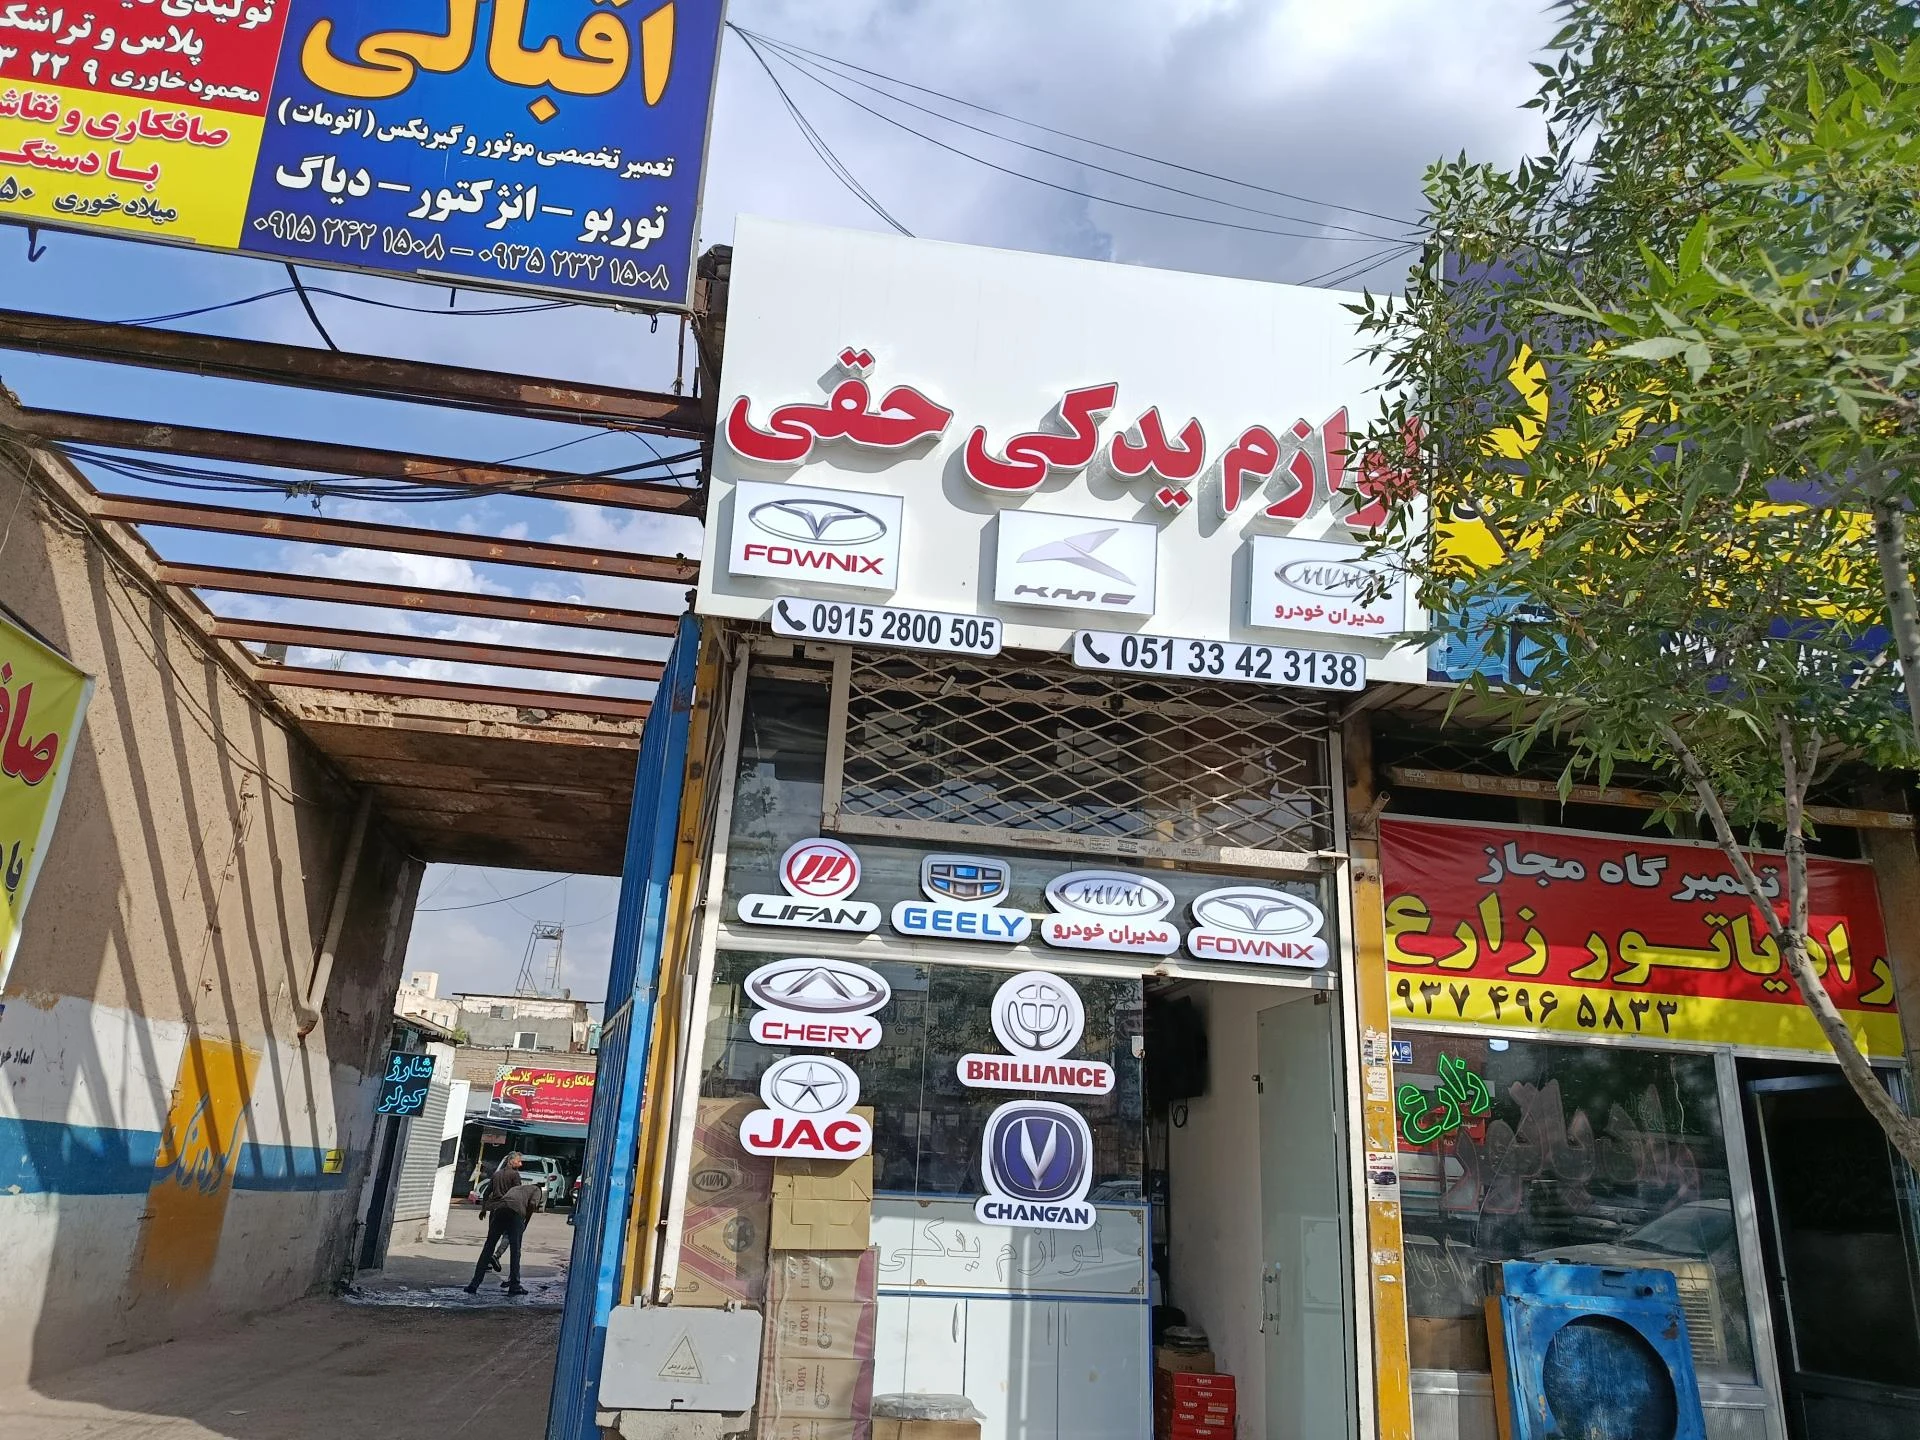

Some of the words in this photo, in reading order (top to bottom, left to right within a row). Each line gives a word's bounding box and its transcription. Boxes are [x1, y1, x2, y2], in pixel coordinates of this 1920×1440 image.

[93, 26, 117, 51] و
[120, 25, 204, 66] پلاس
[82, 58, 99, 86] ۹
[300, 0, 677, 124] اقبالی
[110, 68, 187, 93] خاوری
[188, 77, 261, 103] محمود
[57, 108, 82, 135] و
[84, 107, 230, 147] صافکاری
[376, 118, 464, 151] گیربکس
[463, 135, 478, 156] و
[482, 133, 535, 163] موتور
[536, 143, 621, 176] تخصصی
[106, 149, 161, 190] با
[275, 154, 372, 205] دیاگ
[620, 156, 676, 183] تعمیر
[54, 192, 122, 215] خوری
[124, 197, 177, 222] میلاد
[407, 178, 539, 235] انژکتور
[577, 205, 670, 252] توربو
[254, 210, 316, 245] ۰۹۱۵
[322, 219, 378, 251] ۲۴۲
[382, 226, 446, 262] ۱۵۰۸
[480, 241, 545, 274] ۰۹۳۵
[551, 250, 605, 282] ۲۳۲
[610, 258, 671, 292] ۱۵۰۸
[725, 346, 954, 467] حقی
[963, 382, 1207, 512] یدکی
[743, 543, 884, 576] FOWNIX
[811, 603, 873, 639] 0915
[881, 609, 942, 645] 2800
[950, 618, 995, 650] 505
[1275, 604, 1324, 621] خودرو
[1328, 608, 1385, 627] مدیران
[1120, 635, 1175, 671] 051
[1188, 641, 1225, 676] 33
[1235, 645, 1273, 680] 42
[1283, 650, 1357, 688] 3138
[1478, 841, 1586, 887] مجاز
[1599, 852, 1667, 887] گاه
[750, 902, 867, 926] LIFAN
[903, 907, 1025, 937] GEELY
[1053, 922, 1104, 941] خودرو
[1108, 928, 1169, 946] مدیران
[1385, 891, 1549, 977] زارع
[1196, 935, 1315, 961] FOWNIX
[1395, 978, 1471, 1018] ۹۳۷
[1488, 985, 1559, 1024] ۴۹۶
[1576, 993, 1678, 1034] ۵۸۳۳
[761, 1022, 873, 1045] CHERY
[385, 1055, 433, 1083] شارژ
[966, 1060, 1108, 1089] BRILLIANCE
[377, 1084, 428, 1114] کولر
[1398, 1052, 1490, 1144] زارع
[749, 1118, 861, 1152] JAC
[982, 1201, 1090, 1226] CHANGAN
